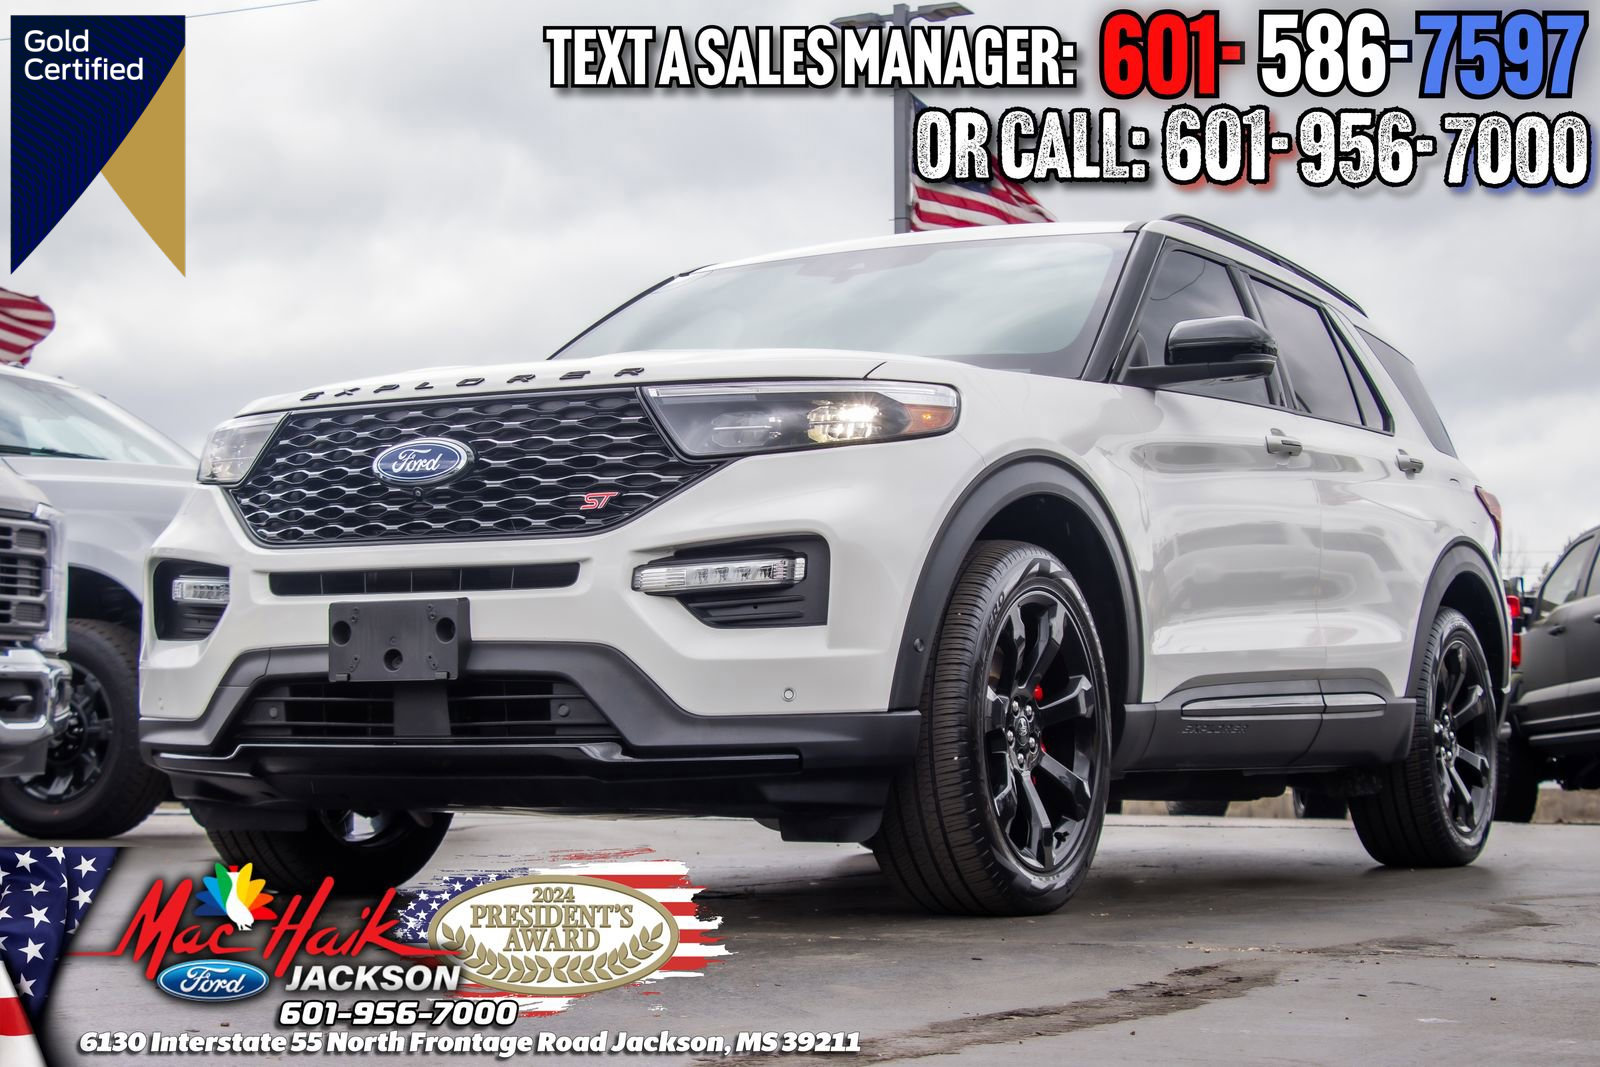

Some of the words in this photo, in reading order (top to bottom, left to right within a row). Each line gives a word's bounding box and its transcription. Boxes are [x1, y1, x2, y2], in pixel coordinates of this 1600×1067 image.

[299, 366, 645, 402] EXPLORER
[391, 447, 442, 474] Ford
[579, 491, 620, 511] ST
